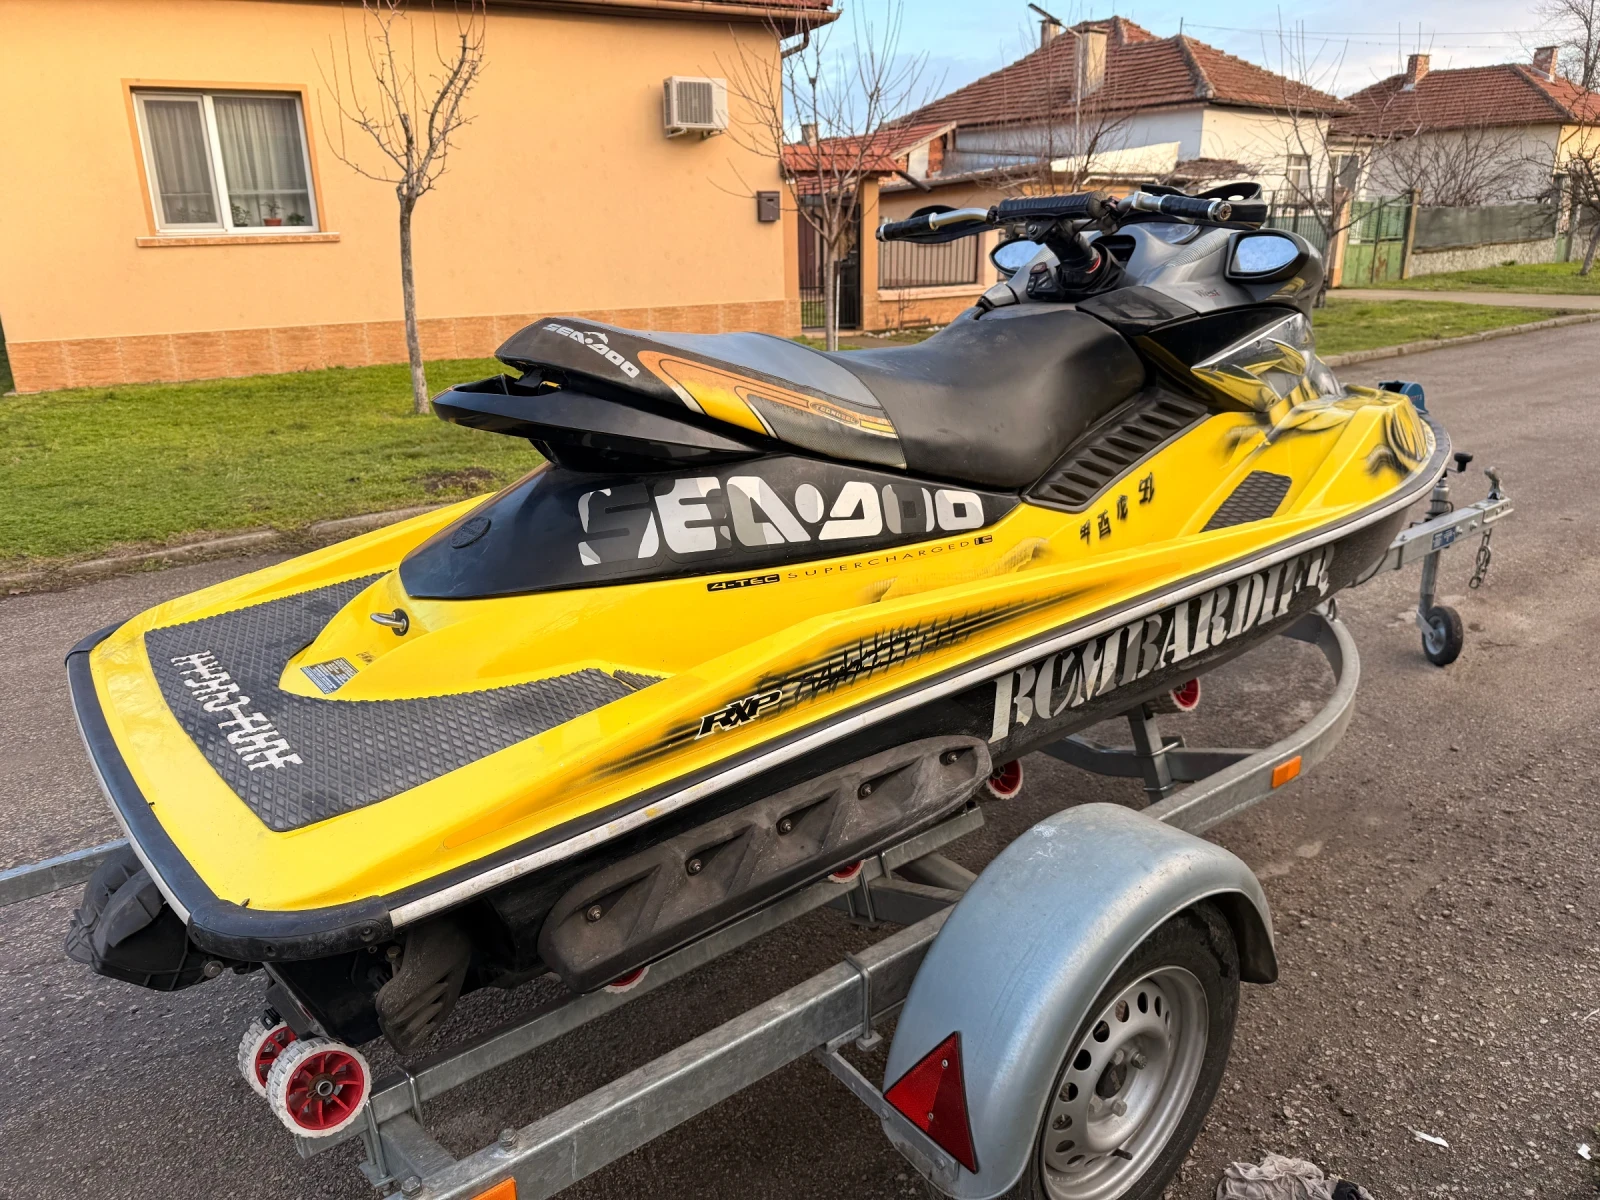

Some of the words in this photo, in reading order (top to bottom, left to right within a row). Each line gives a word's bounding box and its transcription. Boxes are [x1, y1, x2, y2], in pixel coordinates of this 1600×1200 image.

[708, 574, 780, 592] 4-TEC
[787, 540, 970, 579] SUPERCHARGED
[694, 689, 783, 741] RXP
